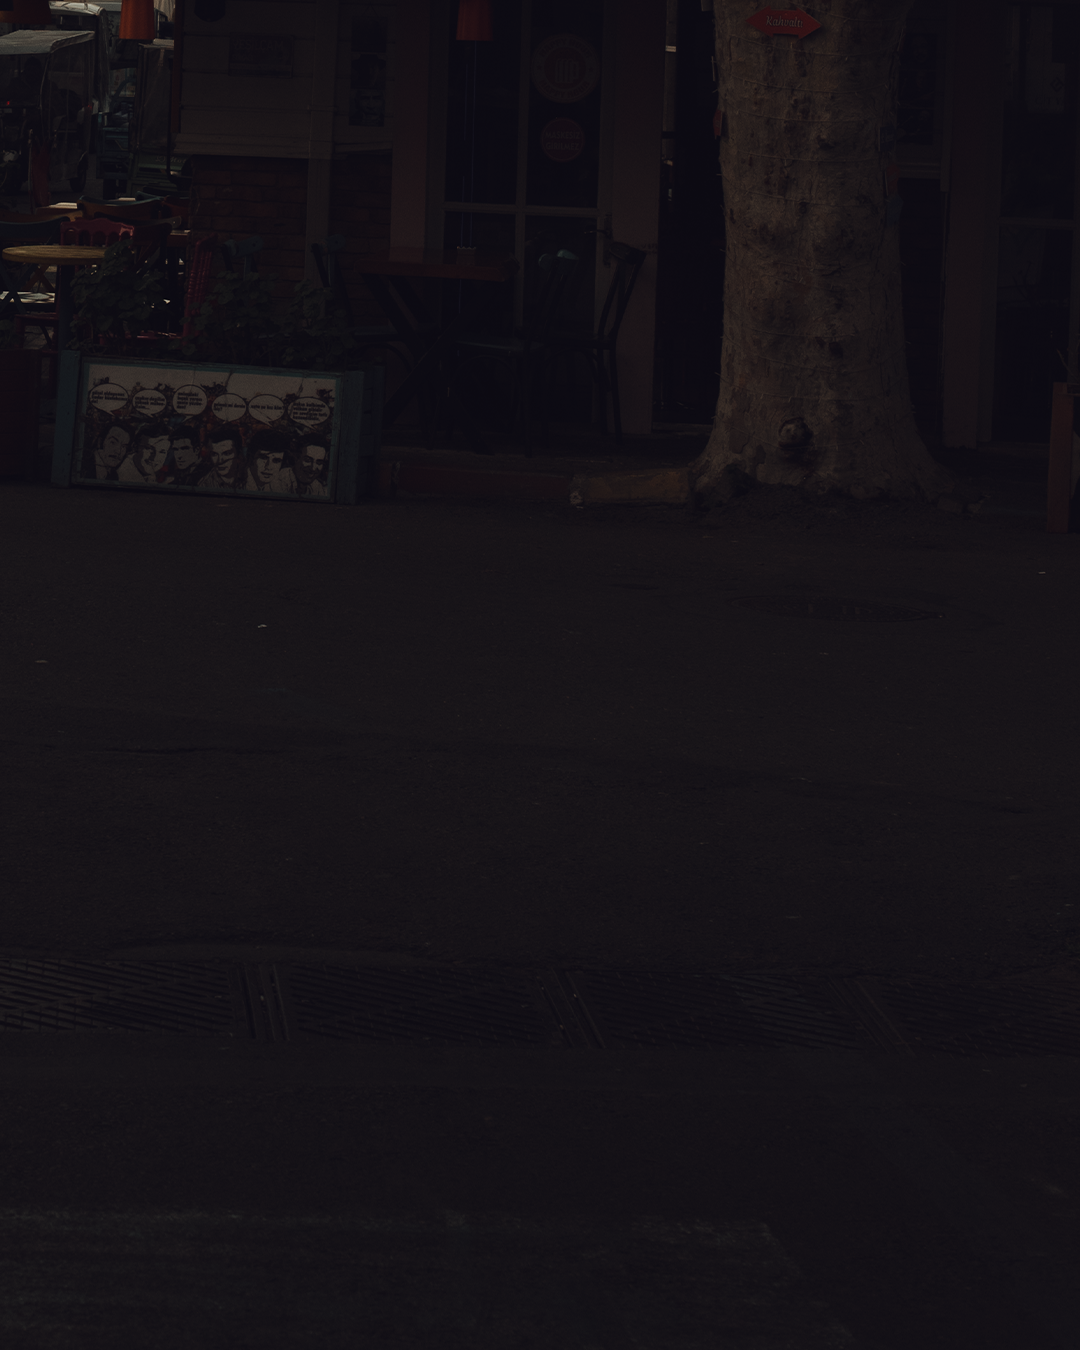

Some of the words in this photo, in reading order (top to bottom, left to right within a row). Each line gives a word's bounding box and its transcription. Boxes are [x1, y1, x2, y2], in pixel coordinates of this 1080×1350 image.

[765, 15, 804, 28] Kahvaltı
[538, 38, 567, 58] HAPPY
[568, 38, 593, 59] HOUR
[538, 79, 566, 98] HAPPY
[566, 80, 590, 98] HOUR
[545, 130, 580, 140] MASKESİZ
[545, 141, 580, 151] GİRİLMEZ
